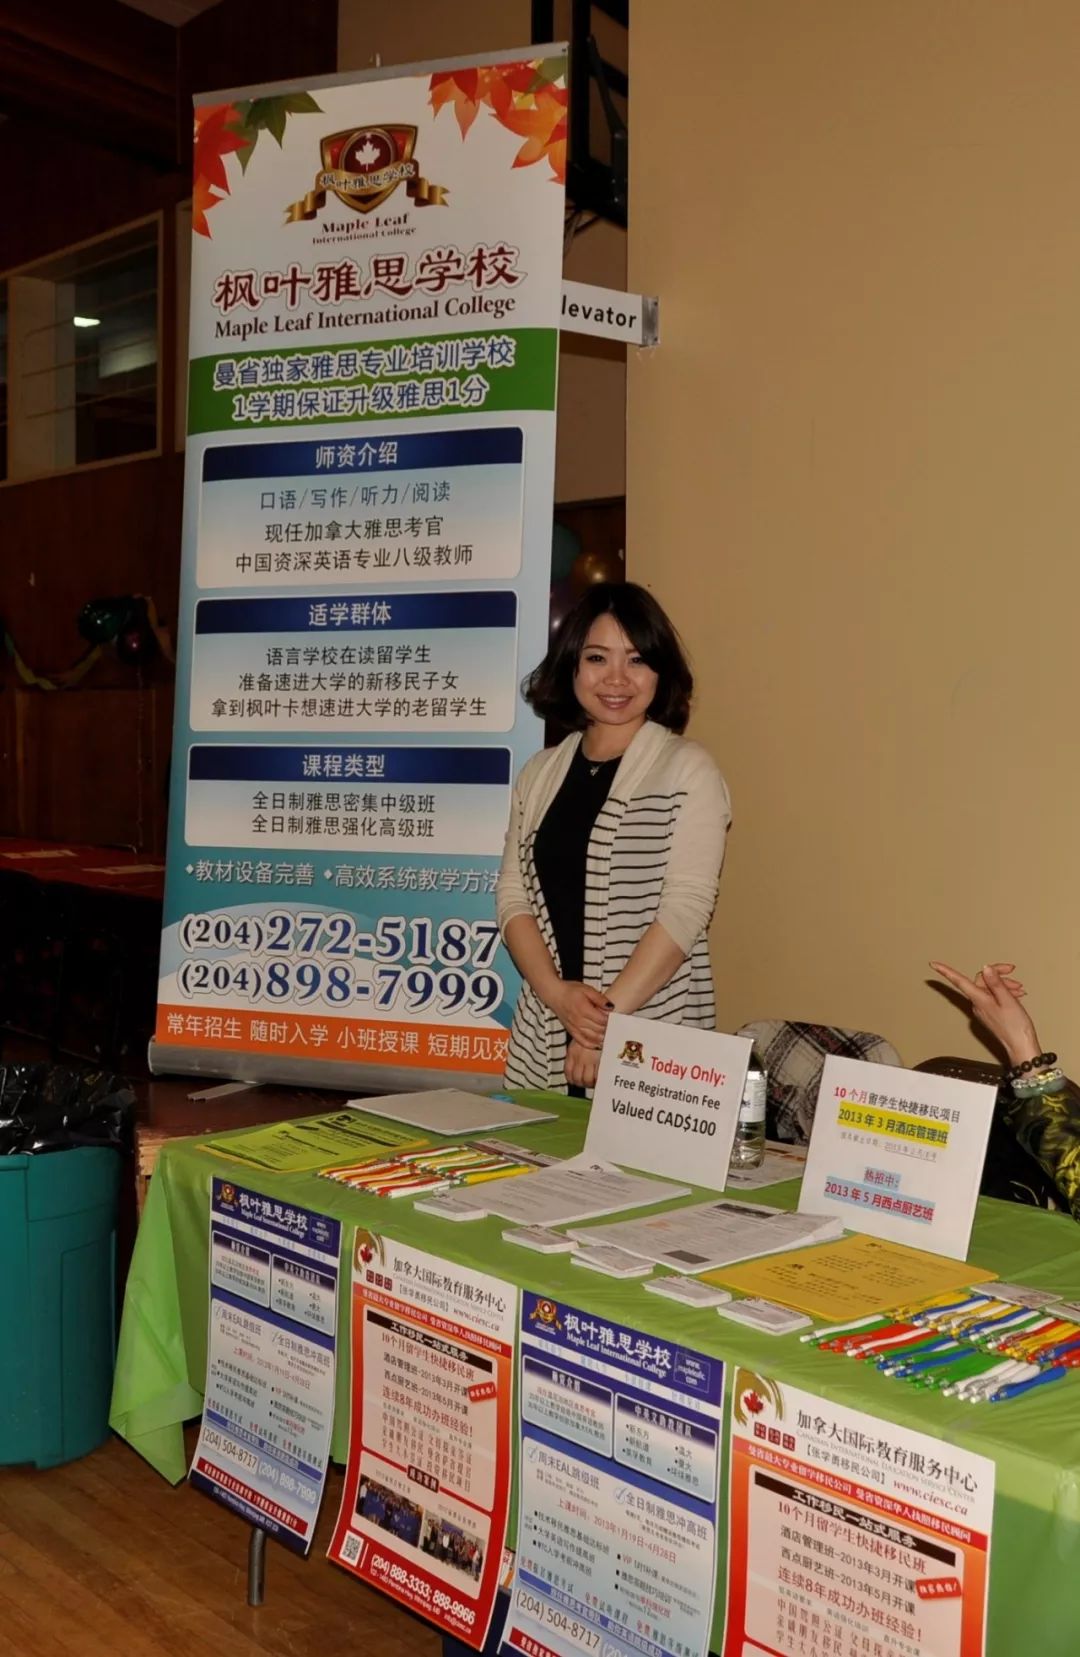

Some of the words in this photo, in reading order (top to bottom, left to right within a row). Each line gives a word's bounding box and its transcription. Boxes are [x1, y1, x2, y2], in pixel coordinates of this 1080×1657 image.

[312, 230, 378, 244] International
[322, 219, 369, 234] Maple
[375, 212, 409, 228] Leaf
[212, 243, 521, 313] 枫叶雅思学校
[215, 317, 268, 341] Maple
[274, 309, 313, 333] Leaf
[317, 300, 439, 330] International
[445, 295, 516, 319] College
[561, 294, 637, 328] levator
[213, 336, 516, 389] 曼省独家雅思专业培训学校
[232, 375, 489, 421] 1学期保证升级雅思1分
[315, 442, 398, 469] 师资介绍
[261, 481, 450, 510] 口语/写作/听力/阅读
[265, 516, 444, 543] 现任加拿大雅思考官
[235, 544, 473, 573] 中国资深英语专业八级教师
[308, 601, 392, 627] 适学群体
[266, 645, 431, 666] 语言学校在读留学生
[238, 671, 459, 692] 准备速进大学的新移民子女
[211, 698, 487, 718] 拿到枫叶卡想速进大学的老留学生
[302, 753, 385, 778] 课程类型
[252, 791, 436, 814] 全日制雅思密集中级班
[252, 815, 435, 838] 全日制雅思强化高级班
[196, 860, 315, 886] 教材设备完善
[335, 864, 501, 894] 高效系统教学方法
[181, 913, 500, 965] (204)272-5187
[179, 960, 500, 1014] (204)898-7999
[166, 1013, 242, 1041] 常年招生
[250, 1019, 328, 1047] 随时入学
[336, 1025, 420, 1055] 小班授课
[650, 1056, 687, 1080] Today
[690, 1065, 726, 1087] Only:
[613, 1075, 636, 1090] Free
[638, 1080, 699, 1105] Registration
[701, 1095, 721, 1110] Fee
[611, 1098, 654, 1122] Valued
[656, 1109, 717, 1137] CAD$100
[239, 1192, 307, 1230] 枫叶雅思学校
[393, 1256, 506, 1314] 加拿大国际教育服务中心
[564, 1311, 672, 1370] 枫叶雅思学校
[566, 1331, 584, 1348] Maple
[587, 1339, 599, 1351] Leaf
[600, 1344, 641, 1368] International
[642, 1360, 666, 1380] College
[201, 1426, 221, 1450] (204)
[796, 1408, 978, 1494] 加拿大国际教育服务中心
[892, 1478, 968, 1516] www.ciesc.ca
[777, 1500, 926, 1575] 10个月留学生快捷移民班
[791, 1489, 917, 1549] 工作移民一站式服务
[780, 1523, 916, 1594] 酒店管理班-2013年3月开课
[371, 1552, 390, 1576] (204)
[432, 1588, 475, 1626] 888-9966
[781, 1546, 916, 1615] 西点厨艺班-2013年5月开课
[516, 1590, 544, 1620] (204)
[547, 1607, 600, 1649] 504-8717
